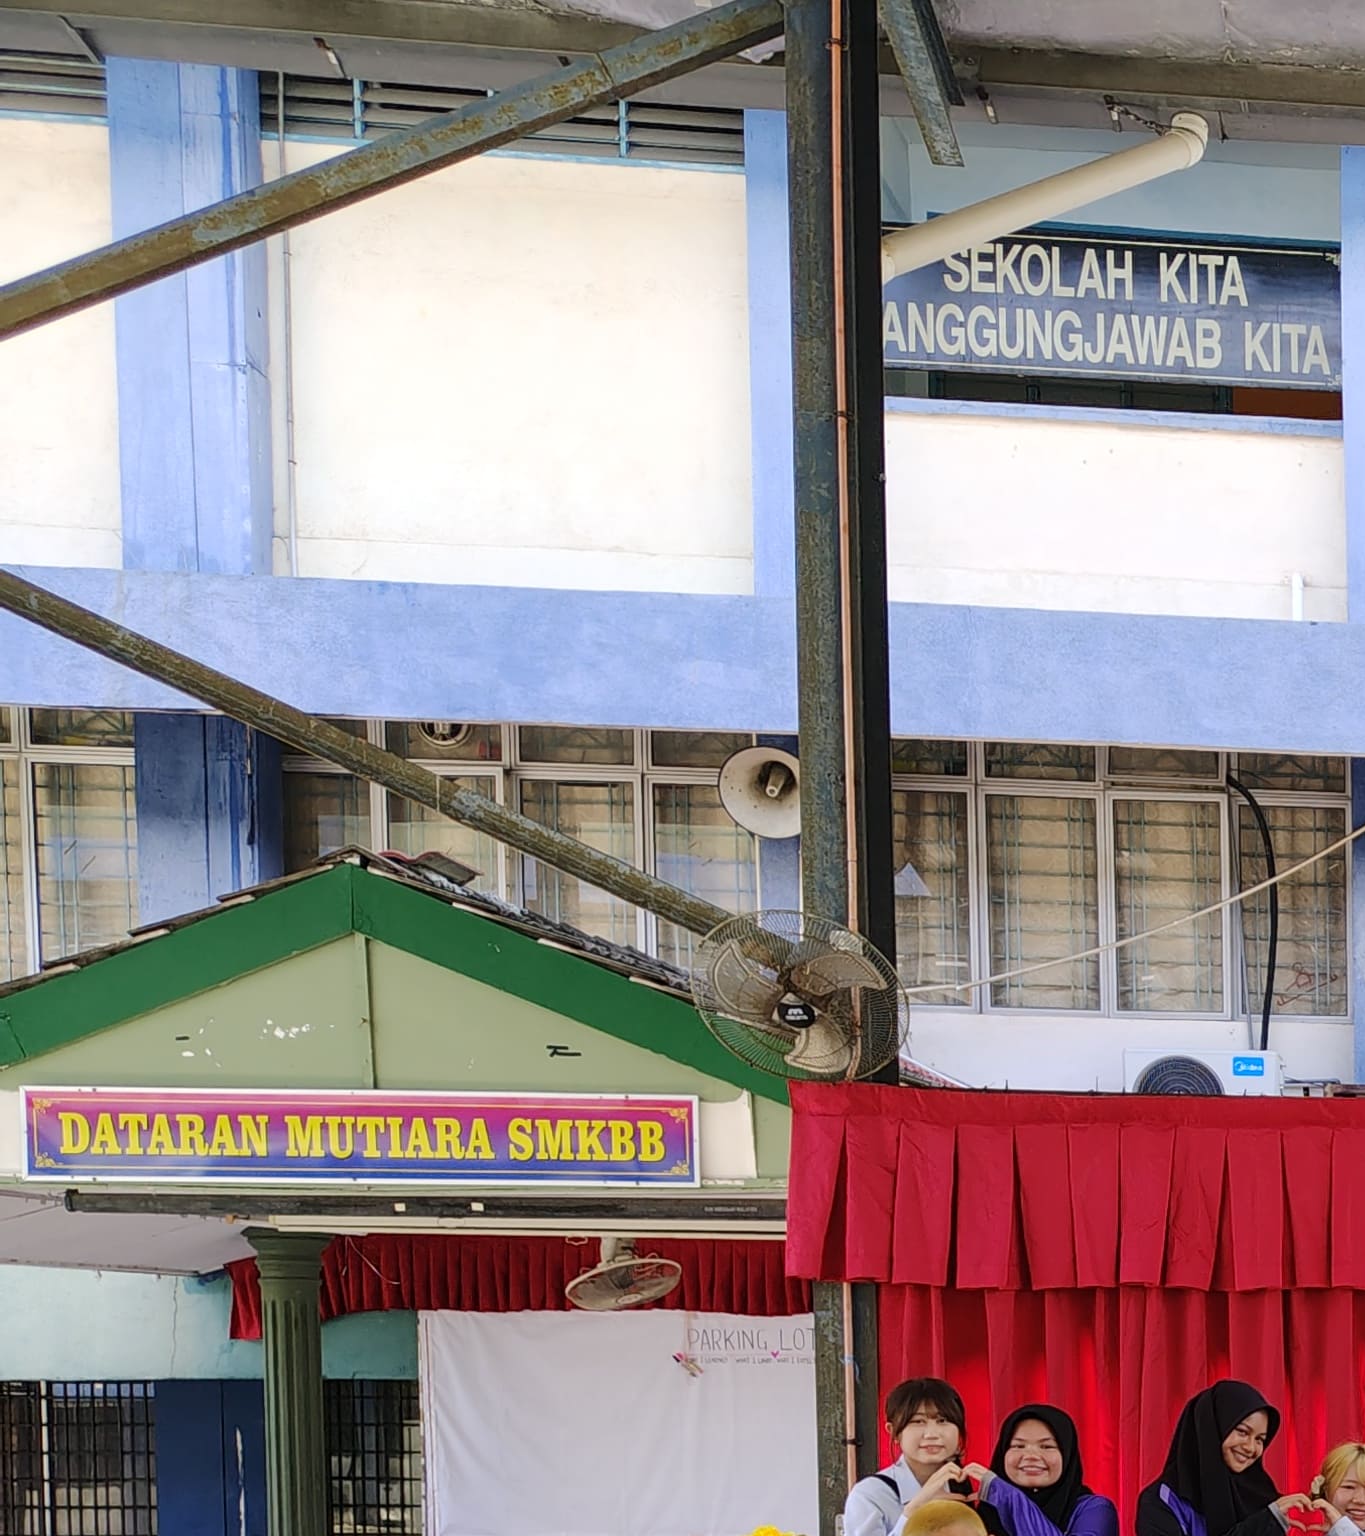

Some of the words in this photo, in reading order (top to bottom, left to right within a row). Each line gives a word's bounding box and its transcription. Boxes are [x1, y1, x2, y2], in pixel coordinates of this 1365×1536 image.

[943, 243, 1133, 300] SEKOLAH
[1159, 252, 1249, 307] KITA
[1244, 321, 1330, 375] KITA
[58, 1111, 270, 1158] DATARAN
[283, 1114, 496, 1160] MUTIARA
[508, 1117, 666, 1163] SMKBB
[688, 1328, 768, 1350] PARKING
